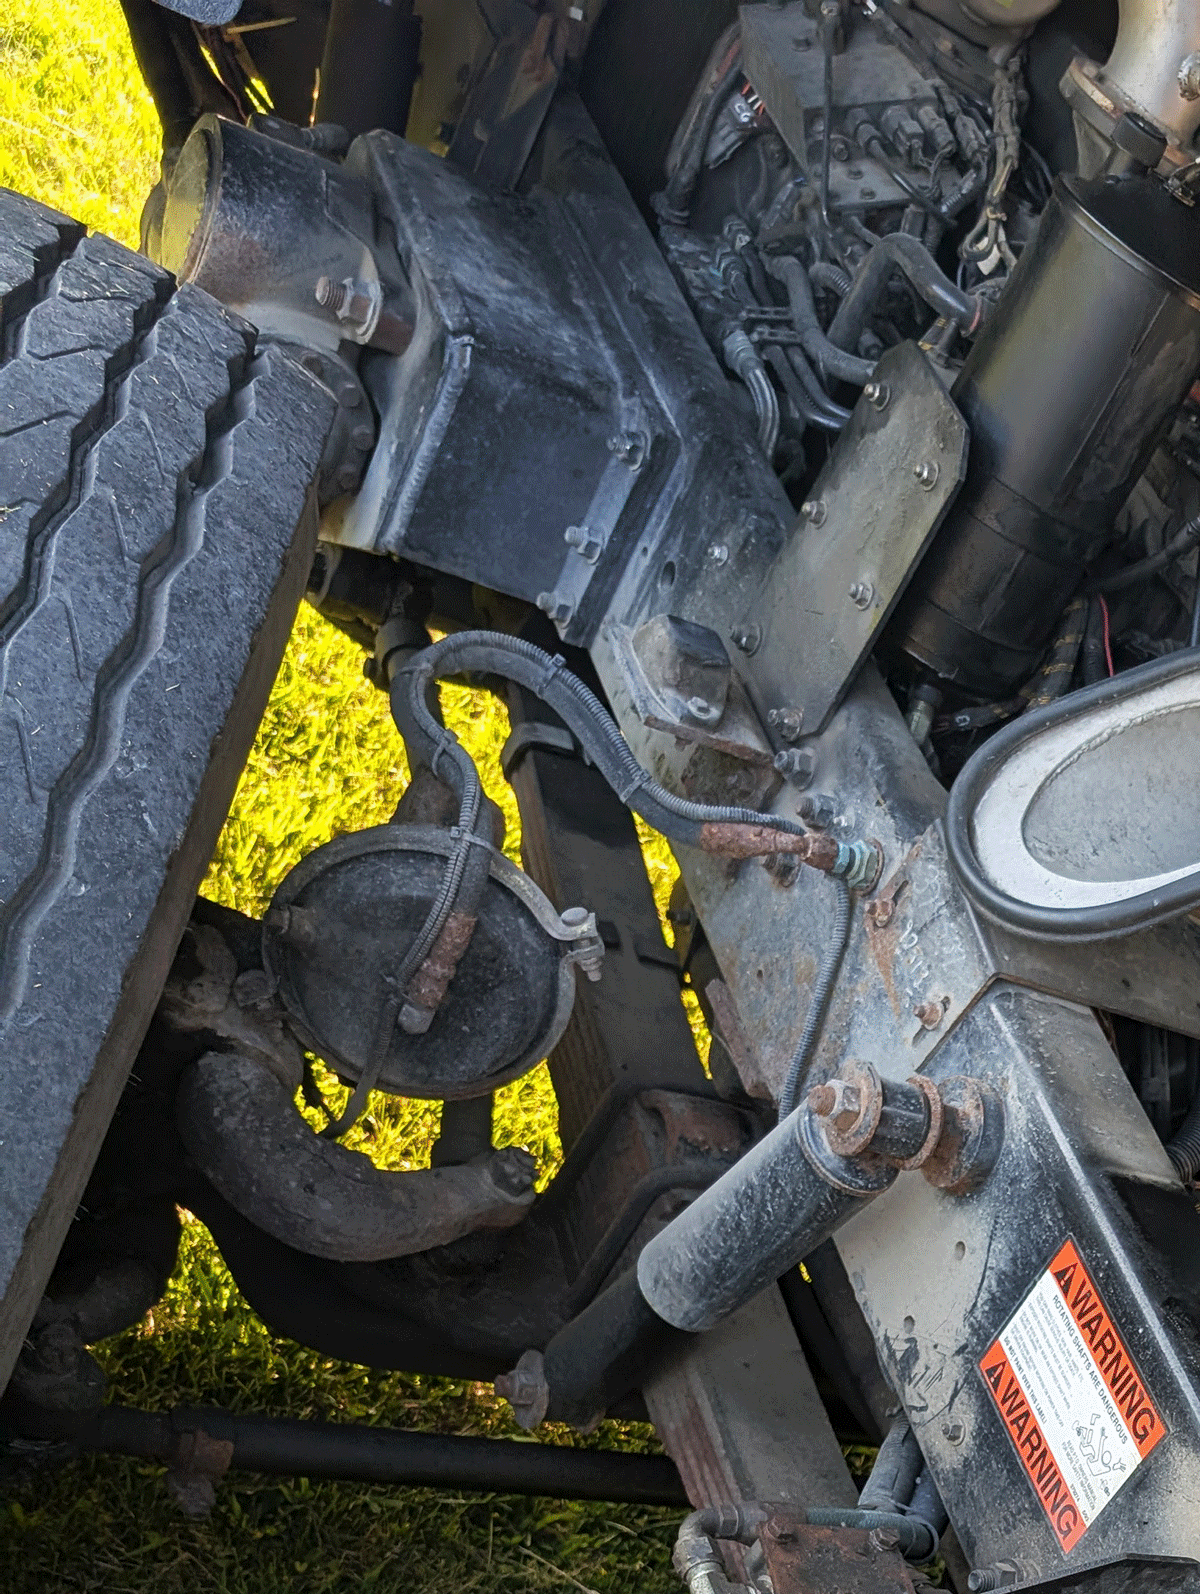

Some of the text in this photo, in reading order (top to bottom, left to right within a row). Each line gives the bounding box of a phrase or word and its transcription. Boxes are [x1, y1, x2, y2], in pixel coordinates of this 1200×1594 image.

[1003, 1335, 1010, 1347] DO
[1007, 1344, 1015, 1358] NOT
[1013, 1356, 1023, 1375] PAINT
[1021, 1373, 1031, 1390] OVER
[1028, 1388, 1037, 1404] THIS
[1052, 1293, 1128, 1445] ROTATING SHAFTS ARE DANGEROUS
[1068, 1278, 1157, 1446] WARNING
[997, 1376, 1080, 1541] WARNING
